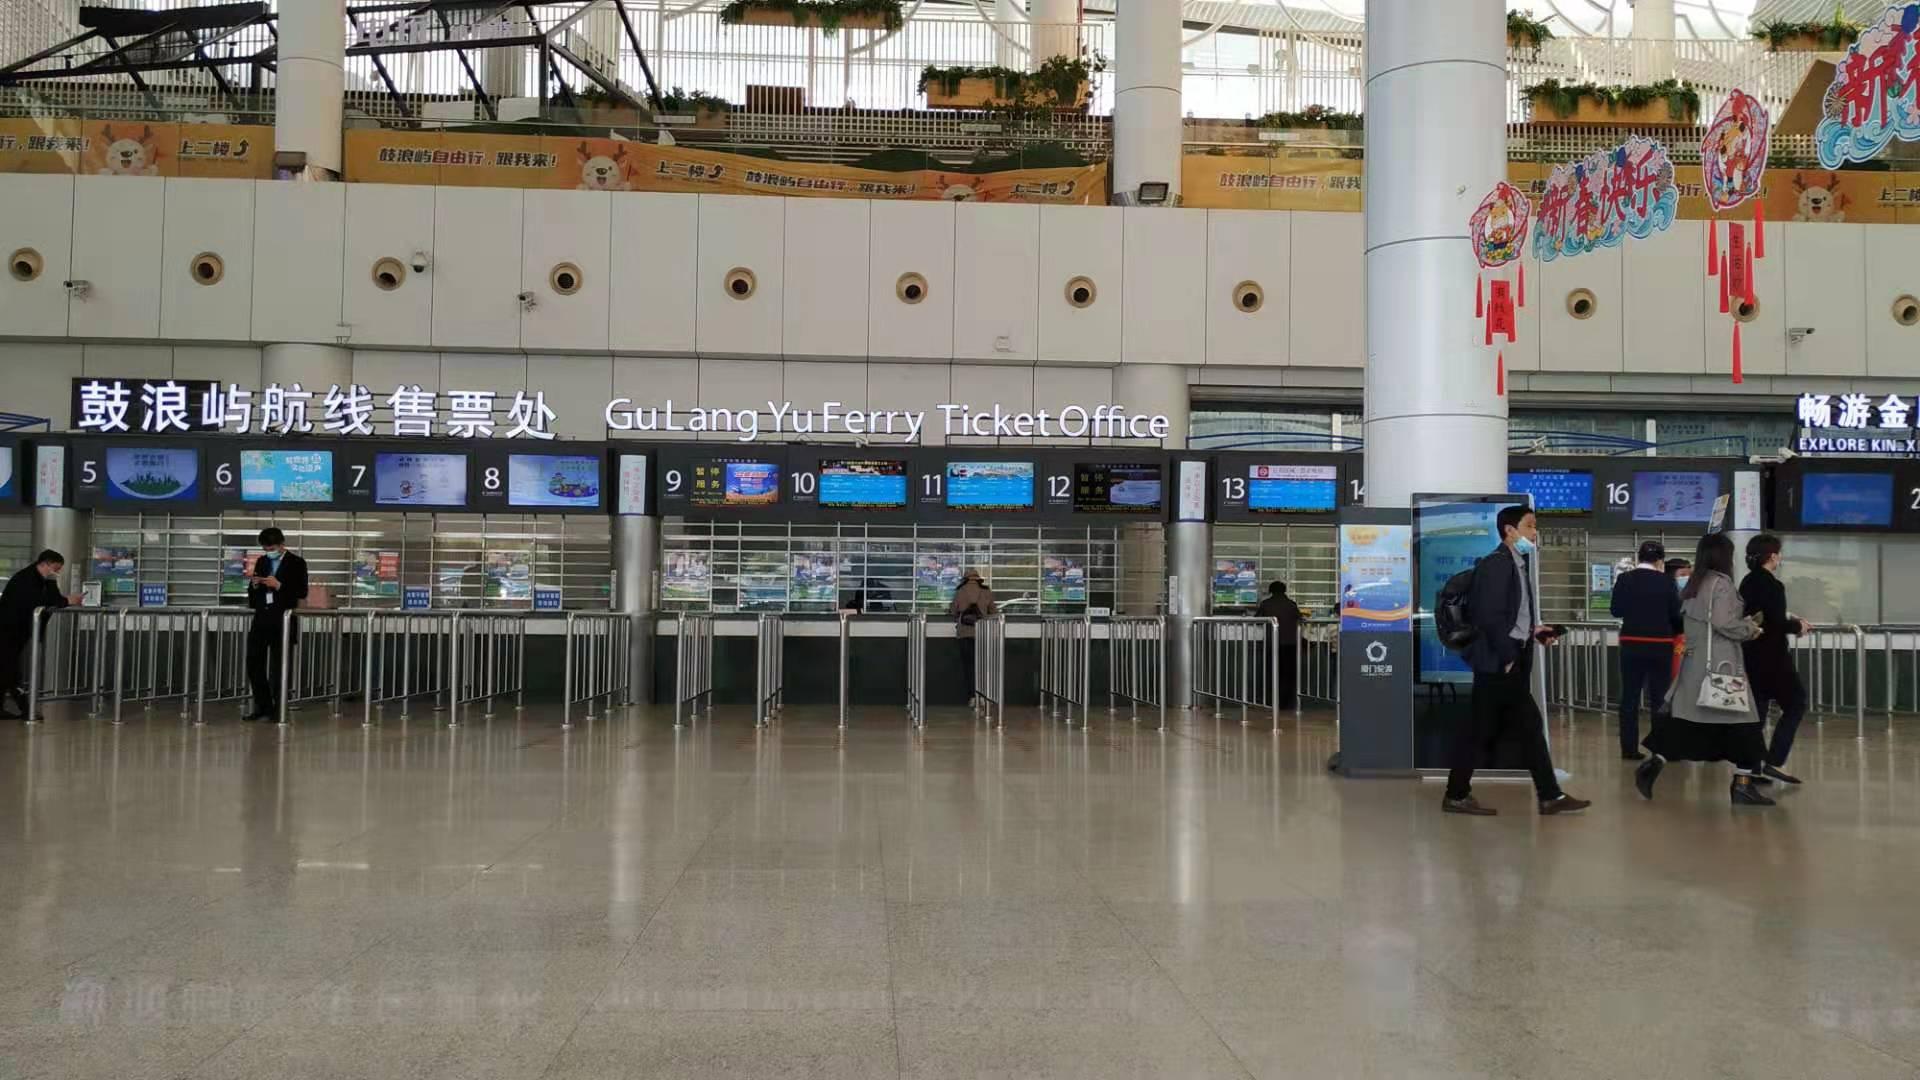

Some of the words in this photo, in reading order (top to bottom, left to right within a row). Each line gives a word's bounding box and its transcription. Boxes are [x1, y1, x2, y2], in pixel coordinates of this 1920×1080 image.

[179, 140, 231, 156] 上二楼
[656, 160, 706, 178] 上二楼
[1536, 148, 1660, 241] 新春快乐
[78, 380, 558, 440] 鼓浪屿航线售票处
[936, 403, 1050, 437] Ticket
[1059, 404, 1170, 438] Office
[1798, 392, 1920, 429] 畅游金
[1799, 438, 1867, 451] EXPLORE
[82, 461, 97, 484] 5
[215, 463, 232, 485] 6
[350, 465, 366, 488] 7
[483, 467, 500, 490] 8
[665, 470, 681, 492] 9
[791, 472, 815, 494] 10
[921, 475, 942, 496] 11
[1047, 476, 1071, 497] 12
[1222, 478, 1245, 499] 13
[1606, 483, 1630, 505] 16
